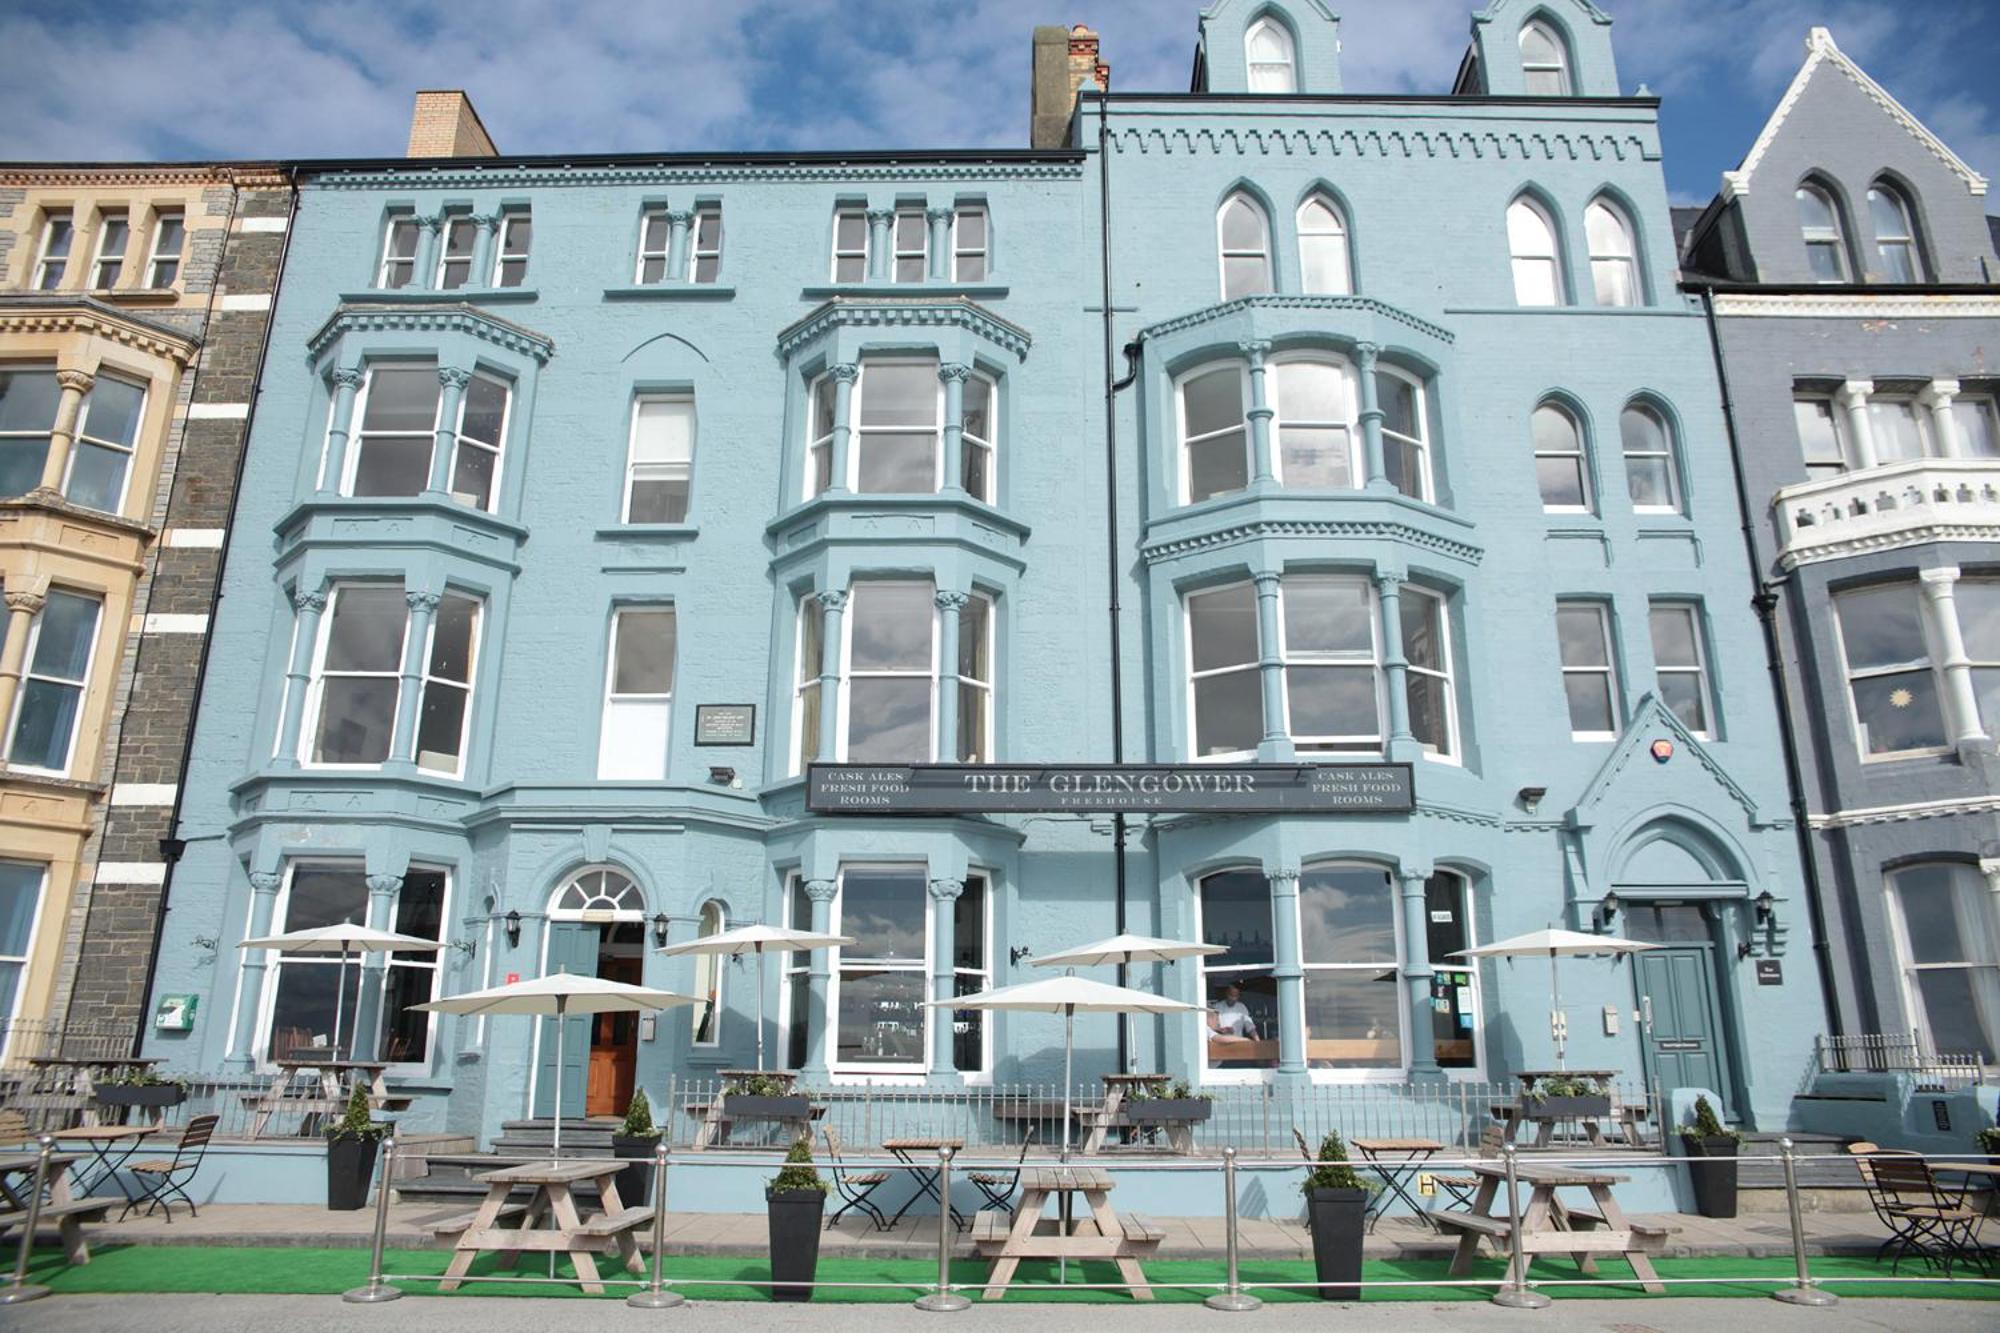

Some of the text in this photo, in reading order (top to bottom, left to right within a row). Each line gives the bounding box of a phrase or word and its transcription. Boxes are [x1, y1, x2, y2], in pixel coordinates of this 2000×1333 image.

[828, 772, 904, 782] CASK ALES
[1318, 772, 1394, 781] CASK ALES
[821, 784, 910, 793] FRESH FOOD
[964, 774, 1257, 793] THE GLENGOWER
[1312, 783, 1401, 793] FRESH FOOD
[840, 796, 891, 805] ROOMS
[1332, 795, 1384, 805] ROOMS
